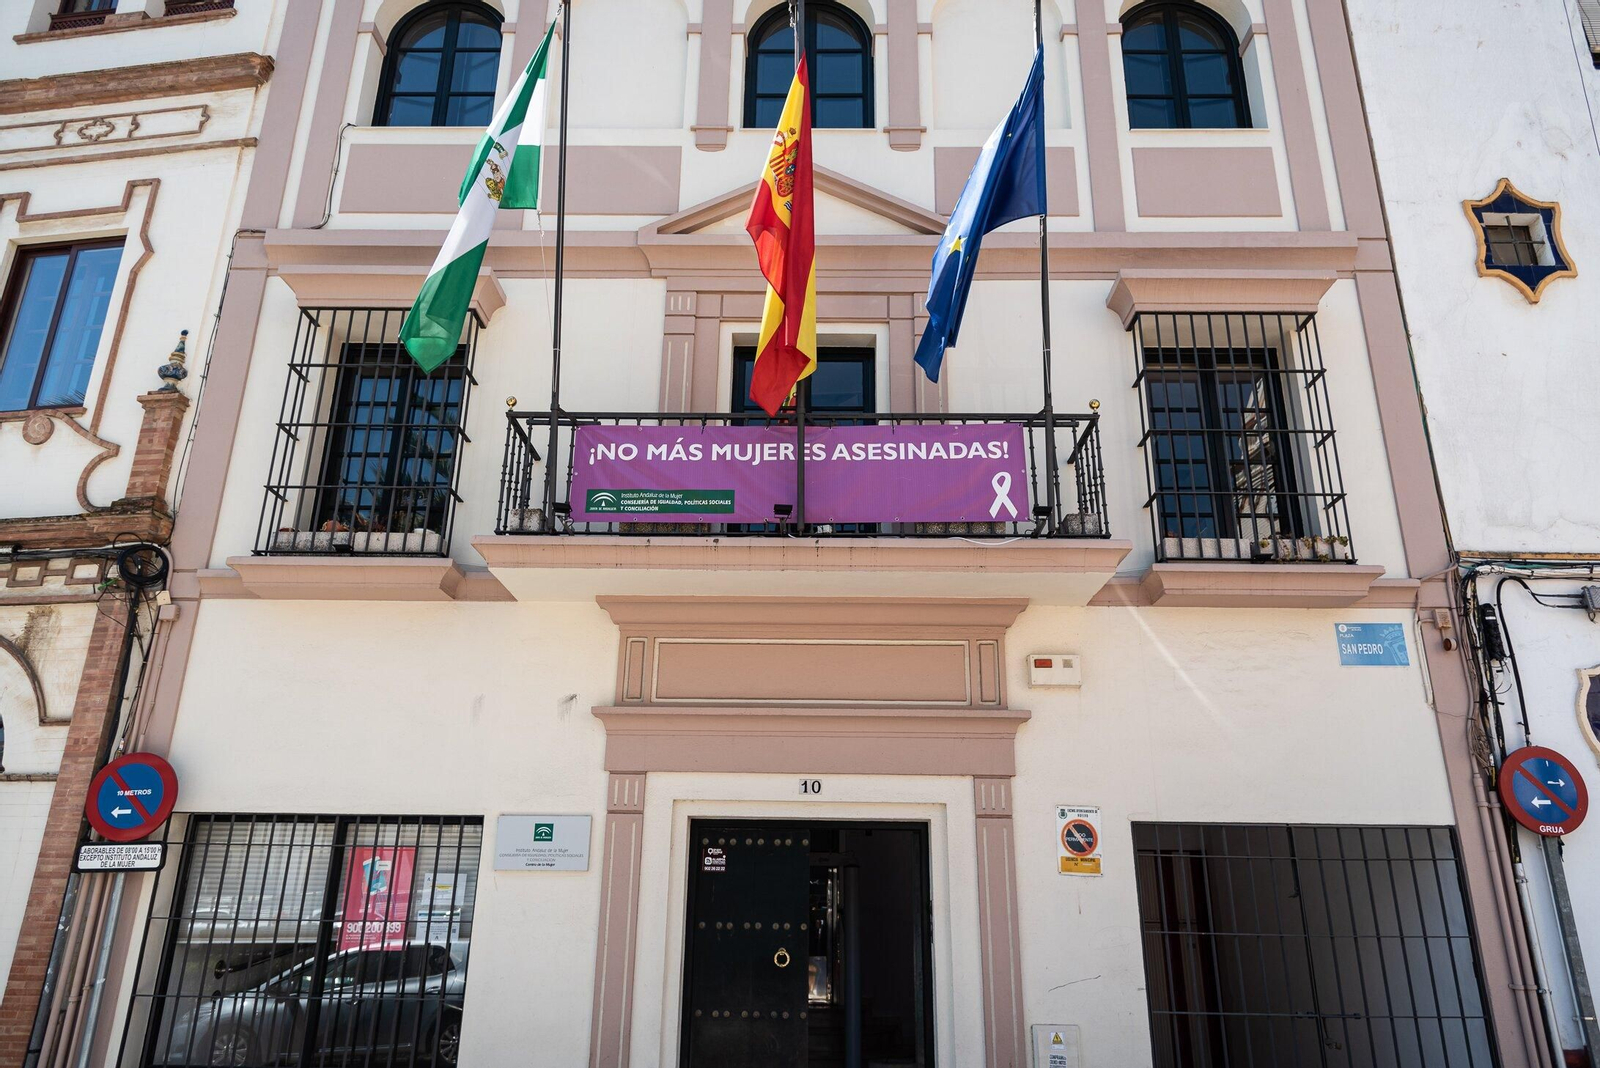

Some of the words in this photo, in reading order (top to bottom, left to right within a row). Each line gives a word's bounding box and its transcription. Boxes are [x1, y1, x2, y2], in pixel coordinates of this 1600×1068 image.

[589, 442, 638, 465] ¡NO
[647, 437, 703, 461] MÁS
[711, 442, 826, 466] MUJERES
[831, 441, 1009, 460] ASESINADAS!
[1341, 643, 1357, 655] SAN
[1358, 643, 1384, 655] PEDRO
[801, 780, 821, 794] 10
[1539, 825, 1565, 834] GRUA
[80, 854, 104, 862] EXCEPTO
[133, 853, 158, 861] ANDALUZ
[365, 922, 384, 933] 200
